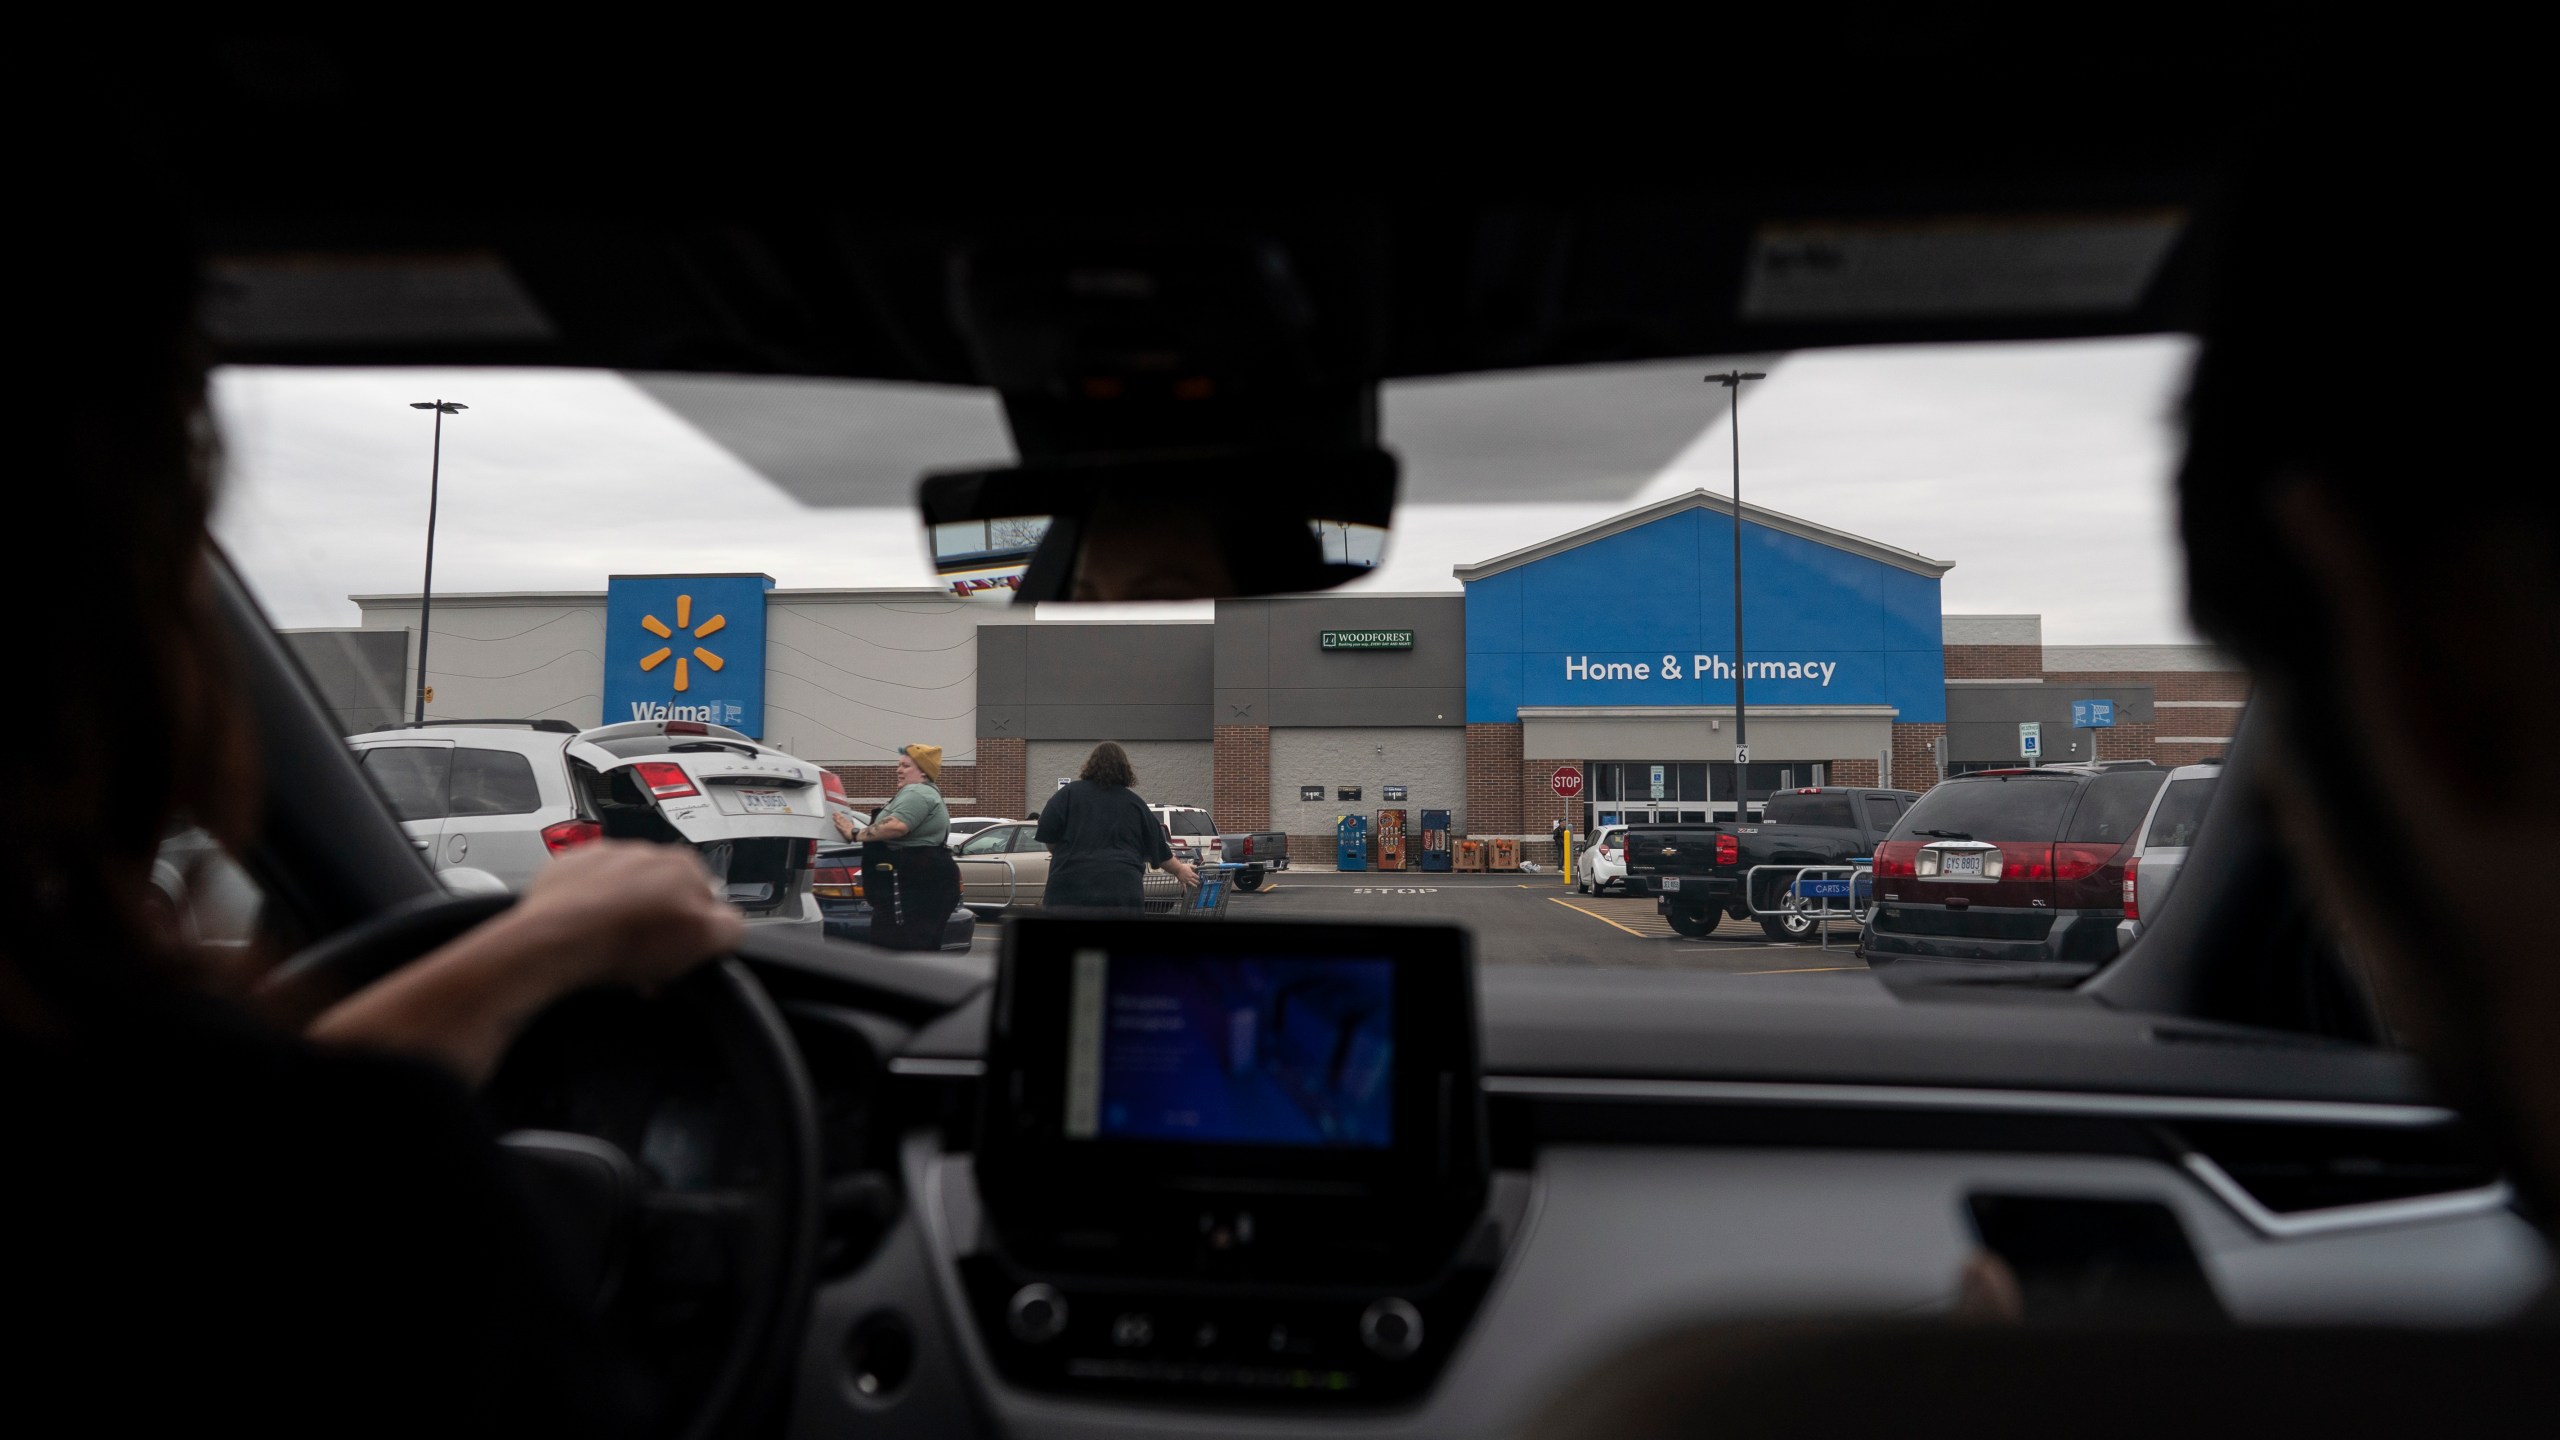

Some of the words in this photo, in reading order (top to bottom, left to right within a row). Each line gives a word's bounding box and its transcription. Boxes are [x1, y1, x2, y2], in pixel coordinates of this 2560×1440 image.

[1338, 633, 1411, 642] WOODFOREST
[1566, 656, 1650, 680] Home
[1661, 655, 1683, 680] &
[631, 701, 711, 721] Walma
[1738, 749, 1746, 763] 6
[1554, 776, 1580, 788] STOP
[1946, 857, 1960, 869] GYS
[1961, 857, 1980, 870] 8803
[1815, 884, 1840, 893] CARTS
[2032, 899, 2046, 907] CXL
